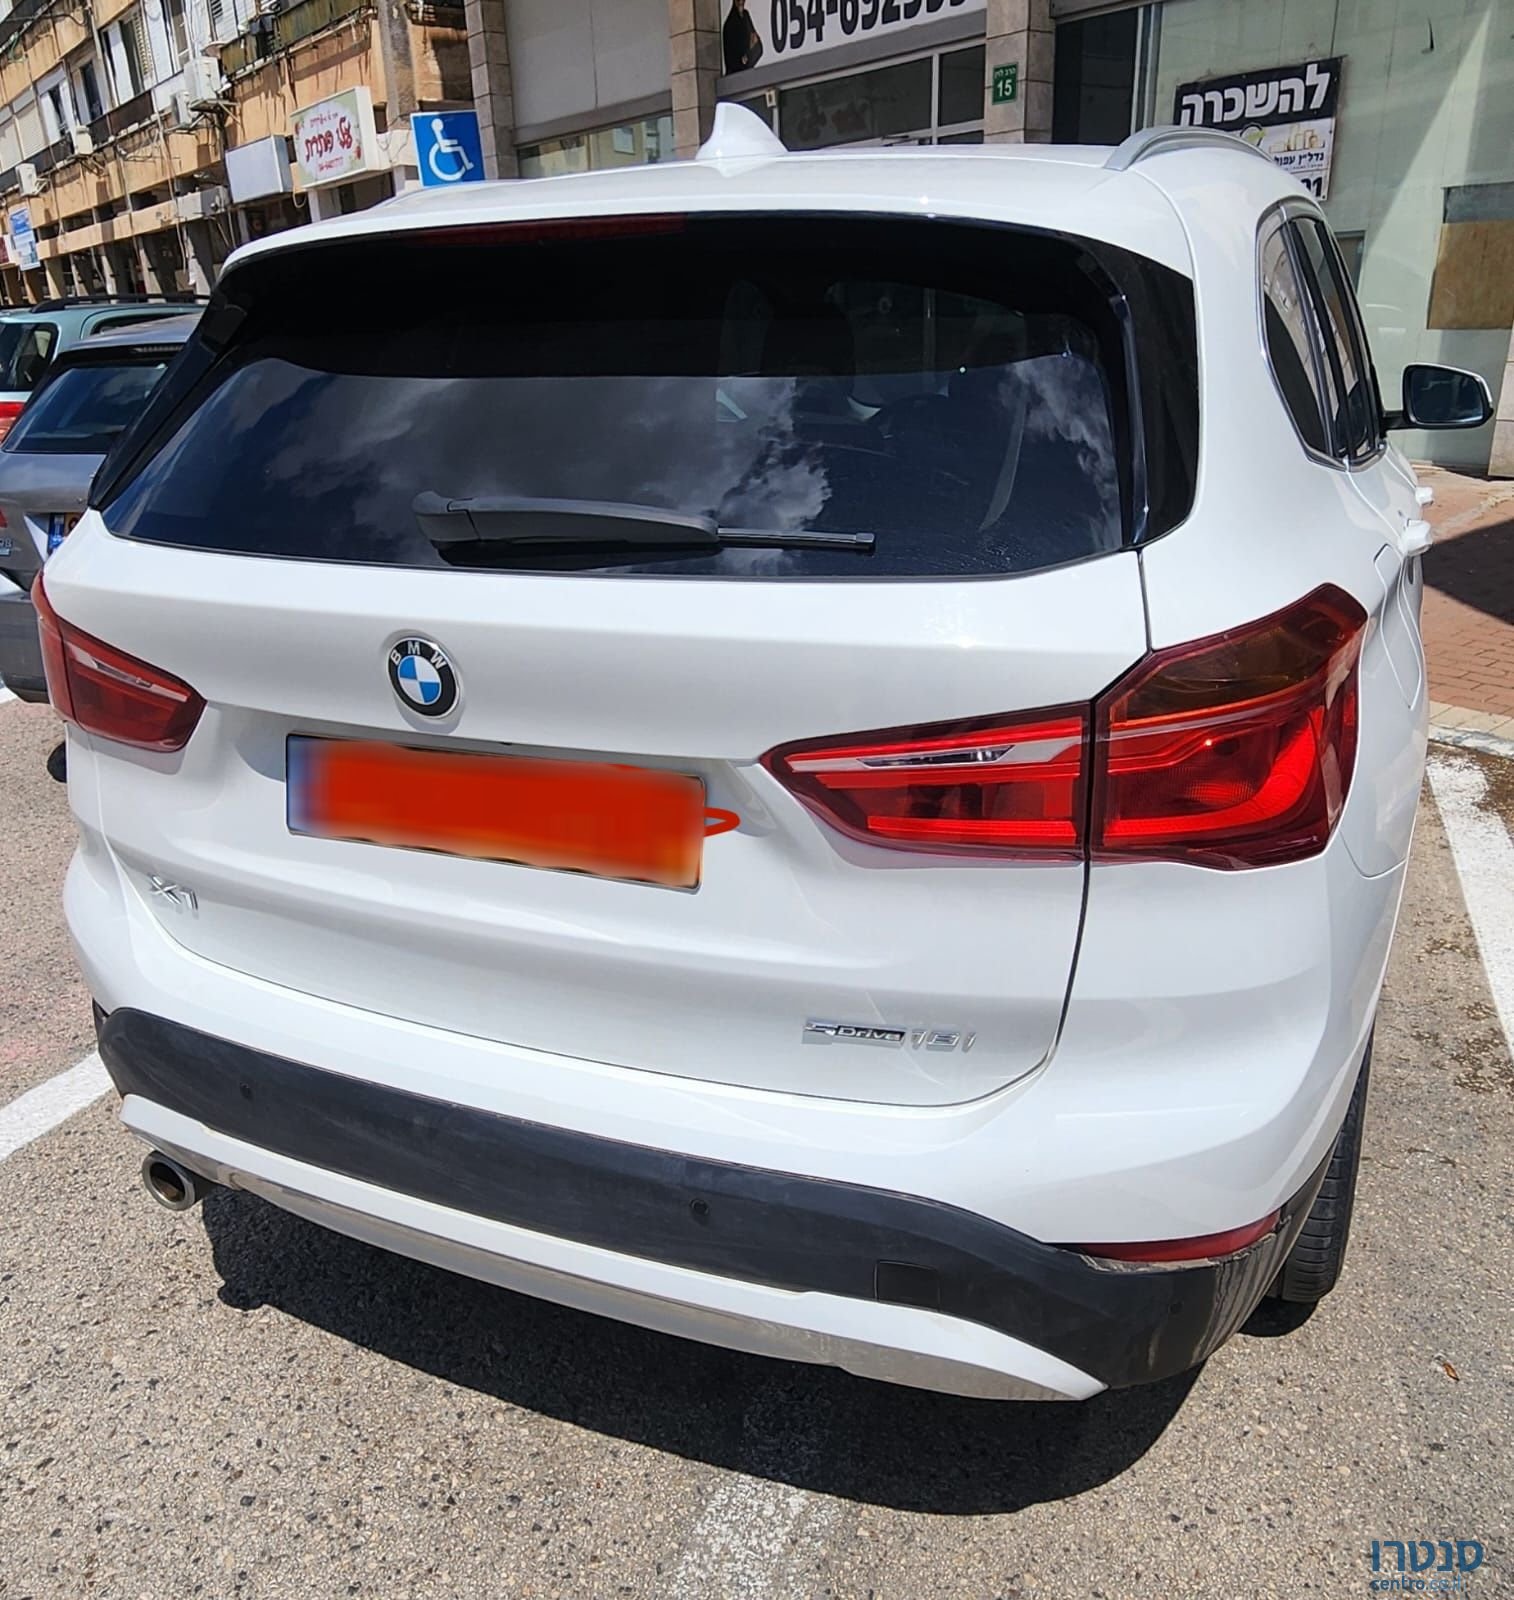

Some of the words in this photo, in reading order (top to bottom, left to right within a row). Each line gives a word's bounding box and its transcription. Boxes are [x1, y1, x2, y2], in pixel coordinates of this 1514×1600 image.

[997, 79, 1013, 97] 15
[1180, 63, 1331, 126] להשכרה
[390, 640, 447, 669] BMW
[149, 874, 199, 913] X1
